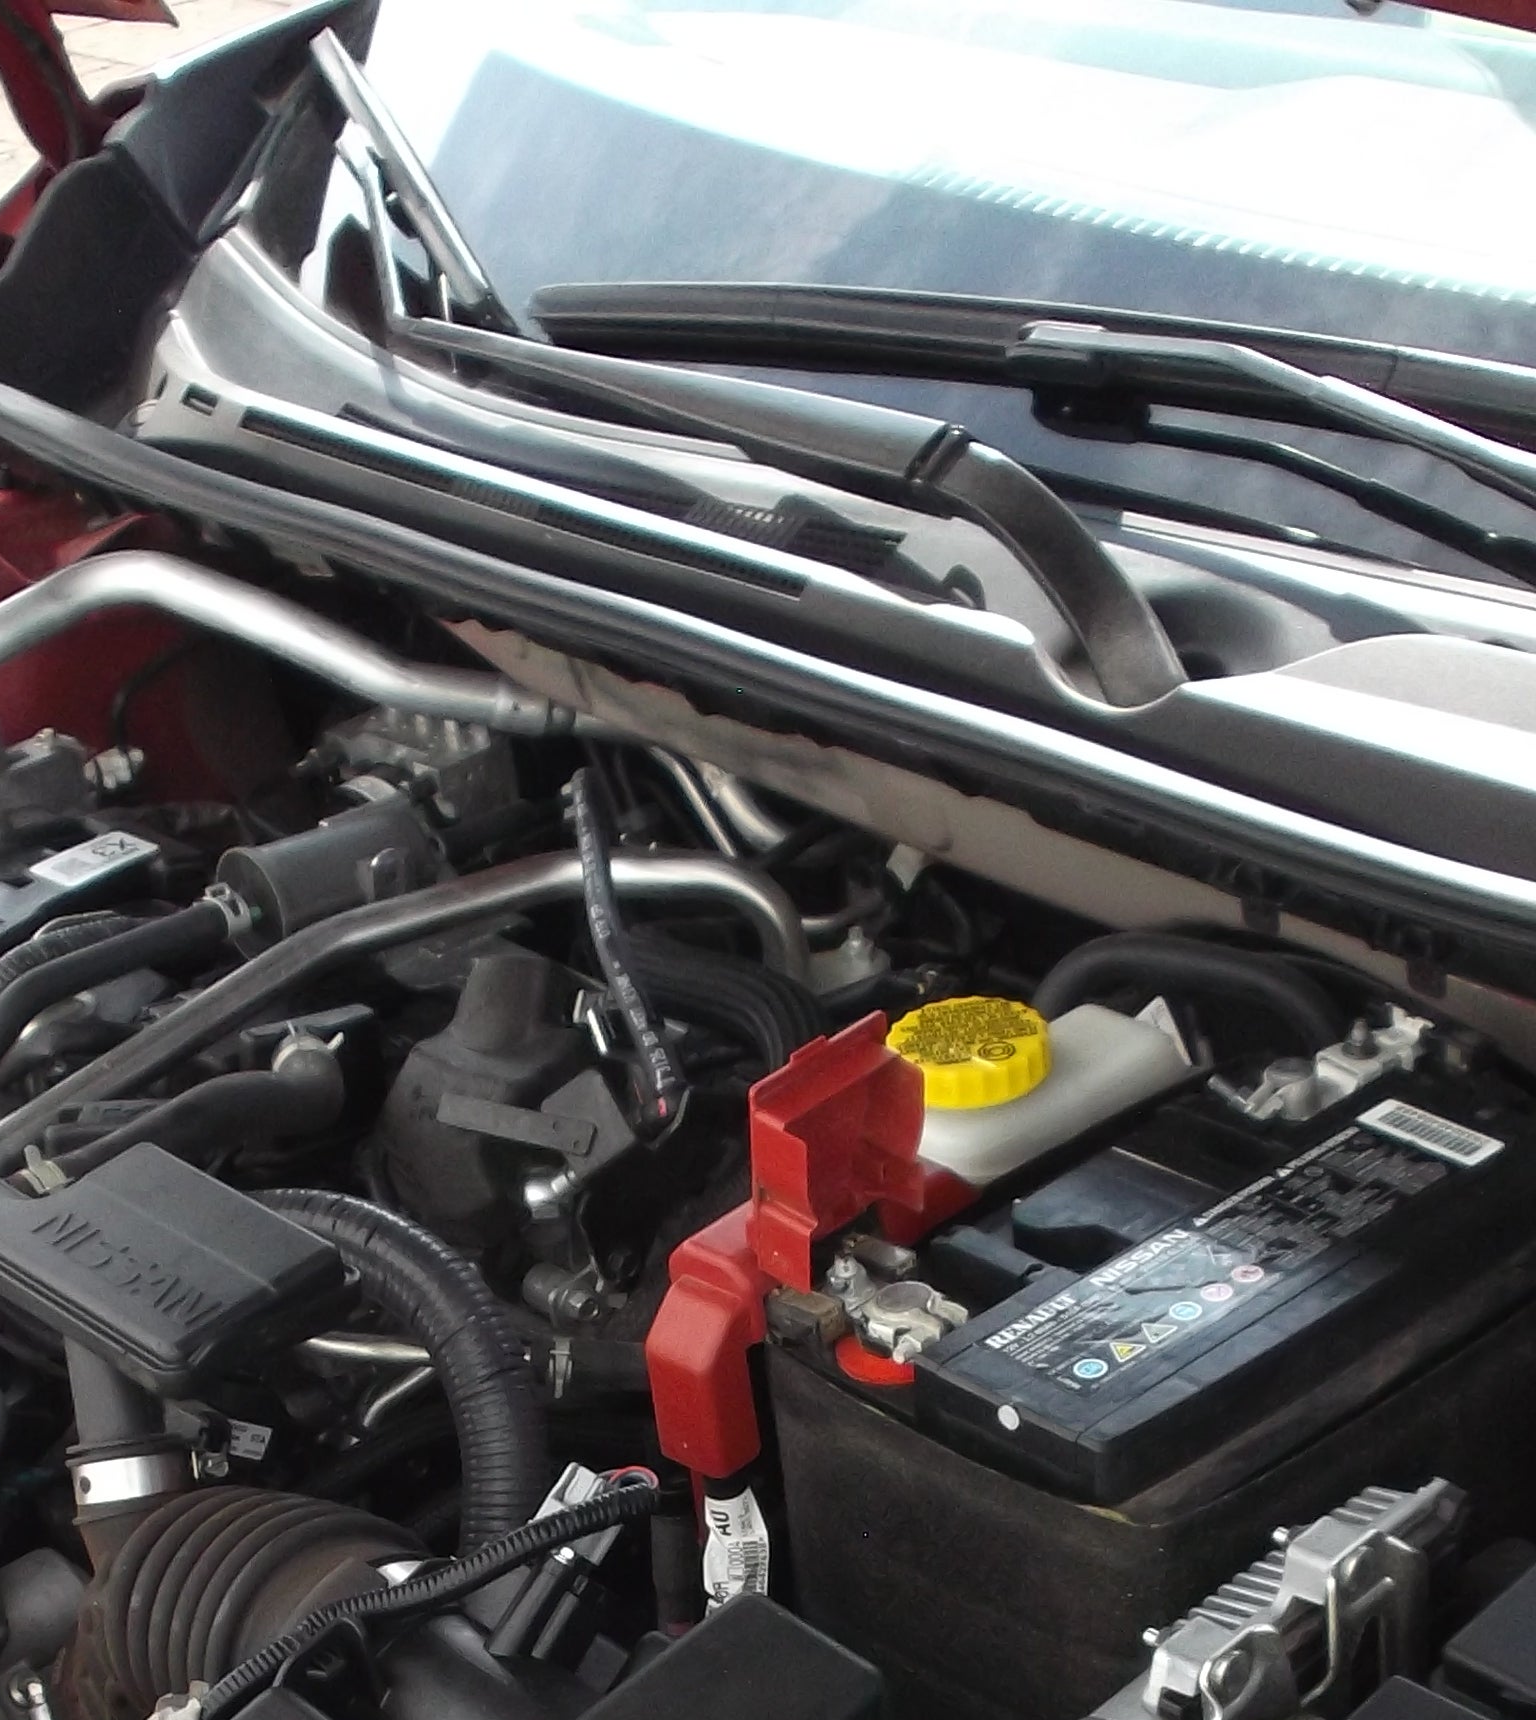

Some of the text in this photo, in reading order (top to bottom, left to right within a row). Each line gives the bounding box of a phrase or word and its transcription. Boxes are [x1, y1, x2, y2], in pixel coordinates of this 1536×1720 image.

[1090, 1228, 1191, 1288] NISSAN
[984, 1292, 1078, 1350] RENAULT
[711, 1510, 731, 1536] AU
